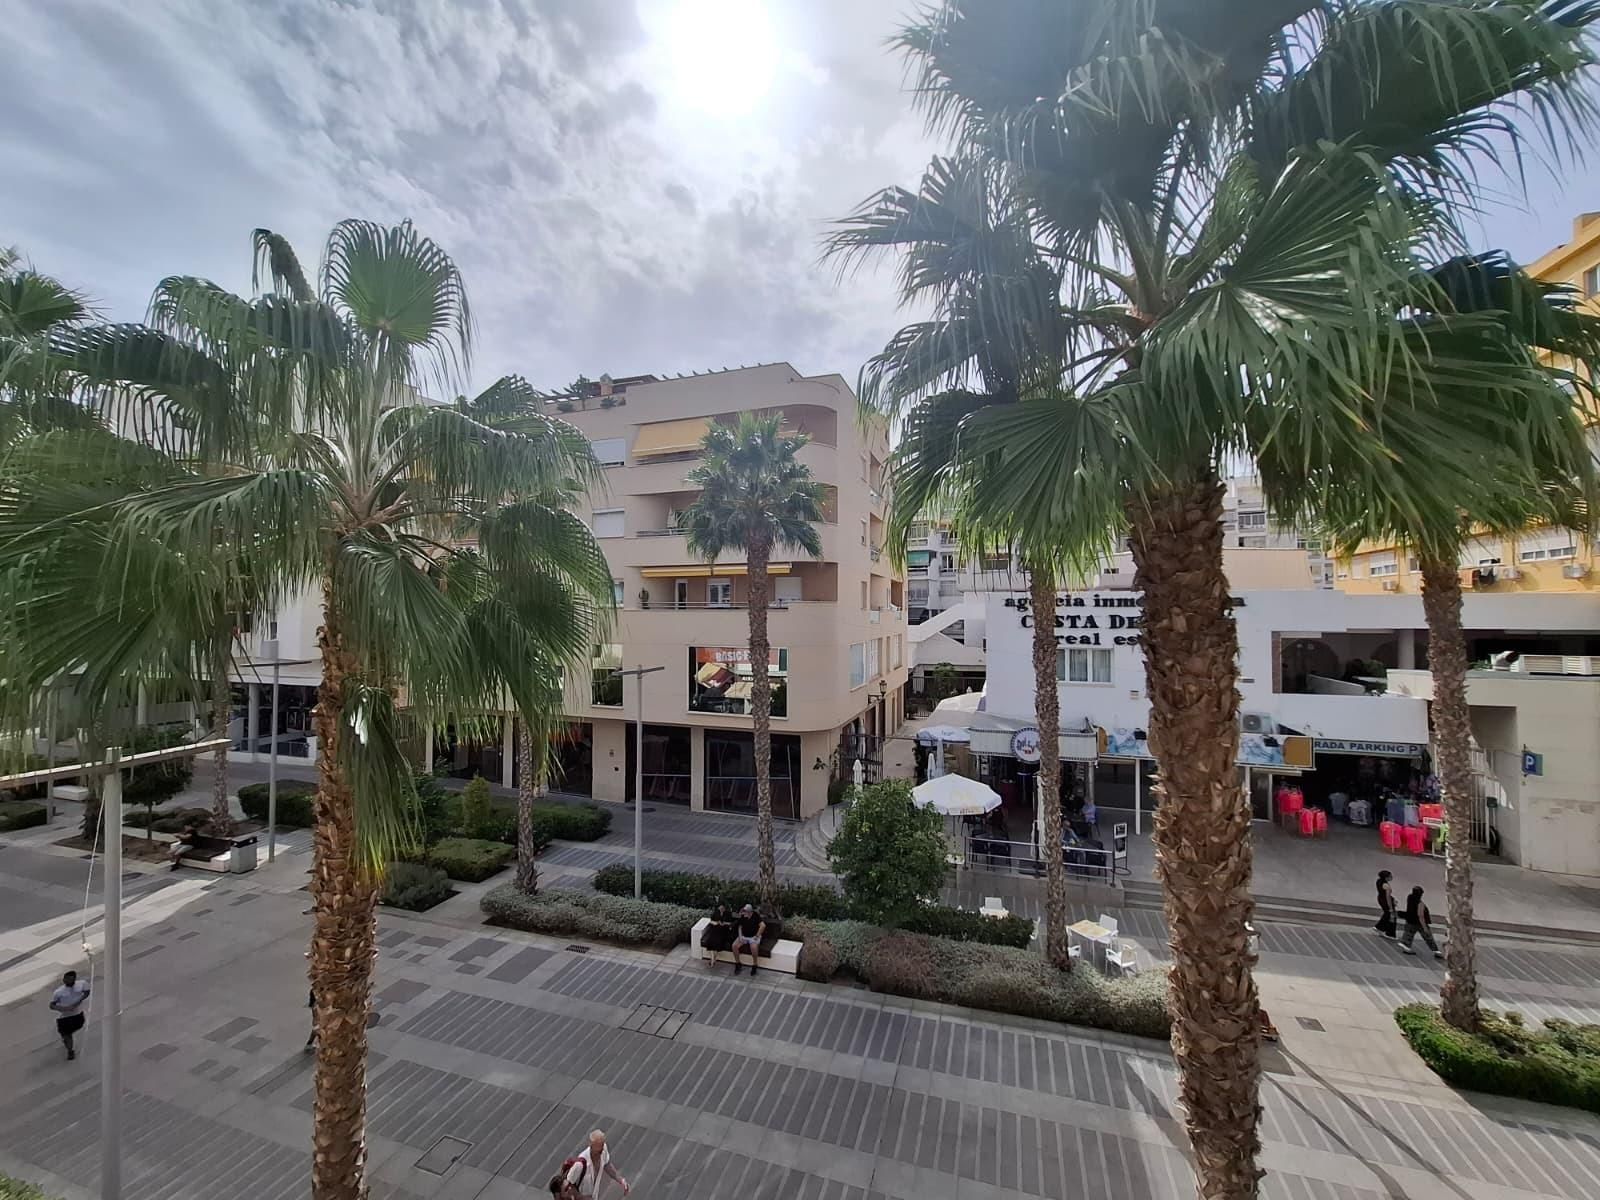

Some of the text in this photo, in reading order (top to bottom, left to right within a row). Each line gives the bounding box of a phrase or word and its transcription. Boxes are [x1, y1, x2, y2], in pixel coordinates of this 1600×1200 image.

[1021, 615, 1144, 629] CSTA DE
[1313, 741, 1345, 750] RADA
[1350, 743, 1405, 753] PARKING
[1525, 754, 1535, 770] P
